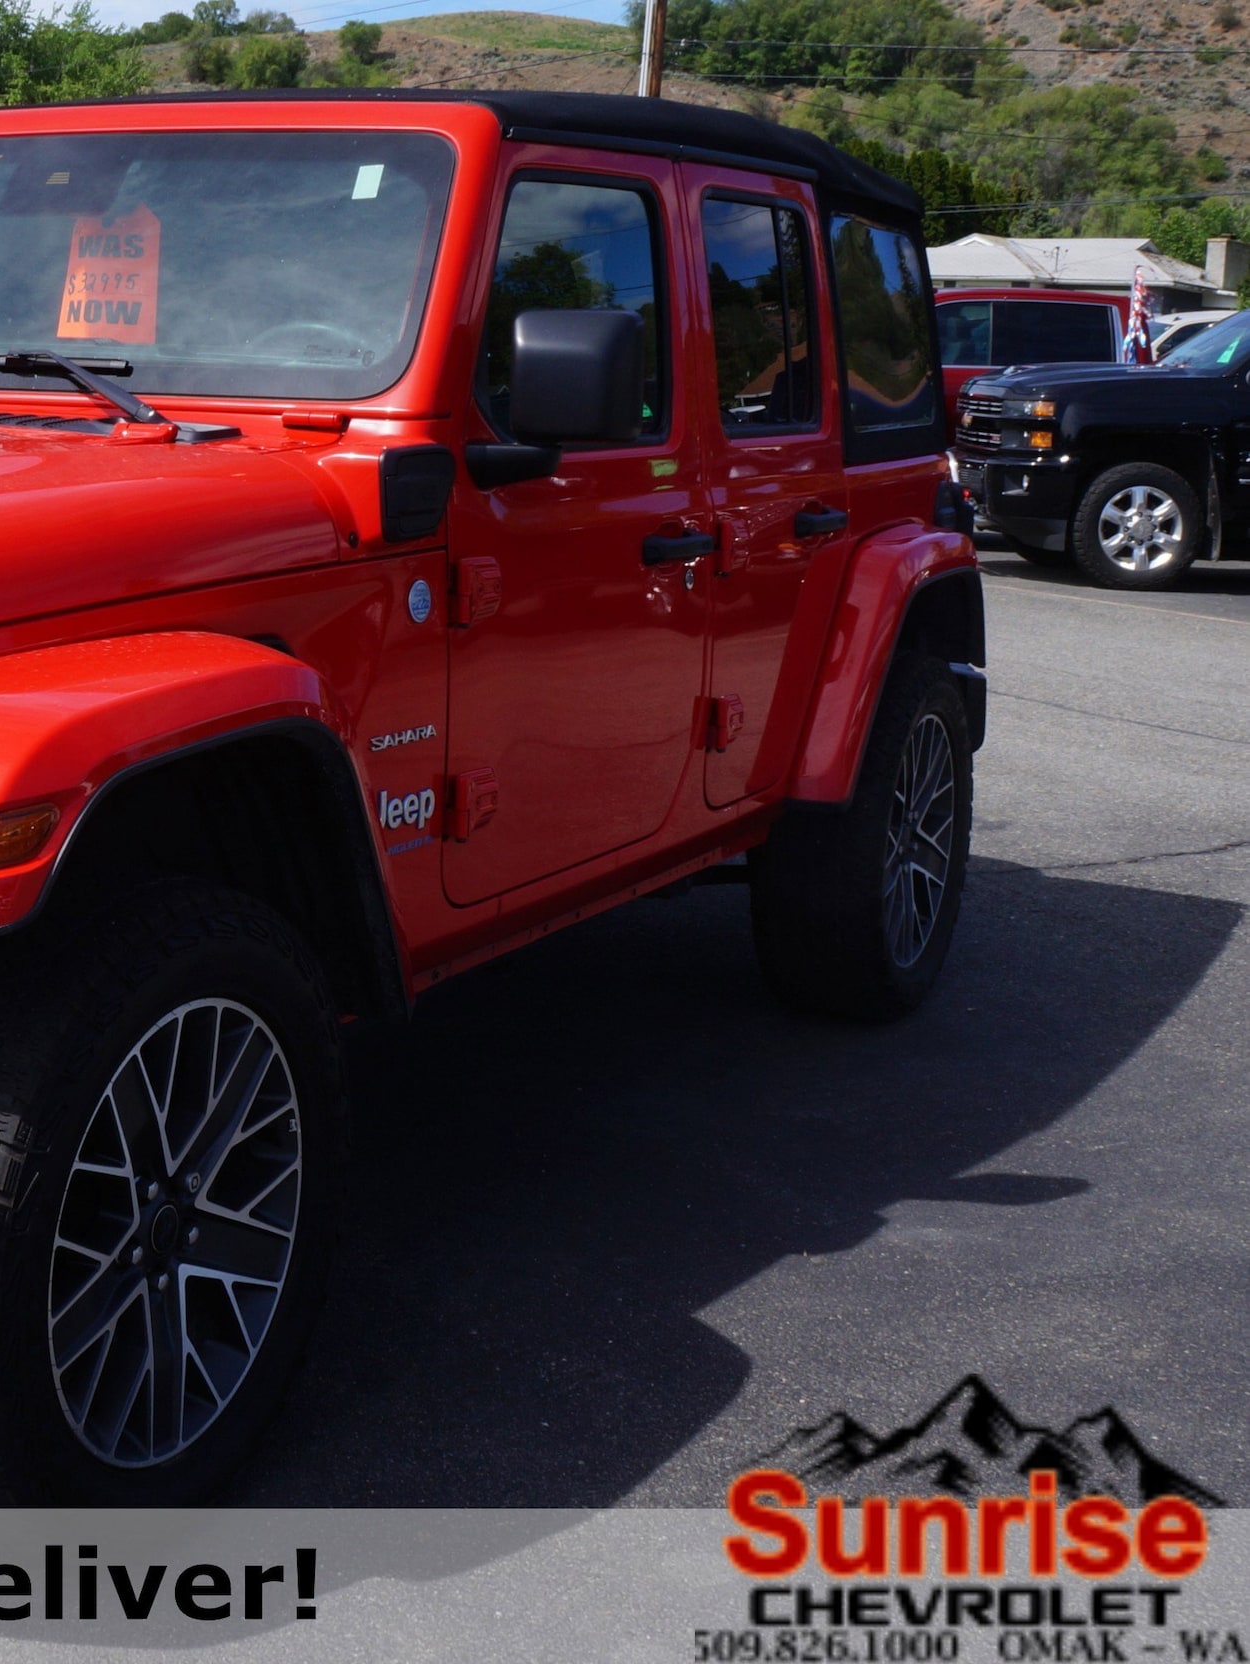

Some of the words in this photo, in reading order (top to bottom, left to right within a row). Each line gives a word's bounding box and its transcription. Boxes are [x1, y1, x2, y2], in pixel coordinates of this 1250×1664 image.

[78, 234, 145, 259] WAS
[67, 300, 143, 325] NOW
[370, 725, 437, 751] SAHARA
[379, 788, 436, 830] Jeep
